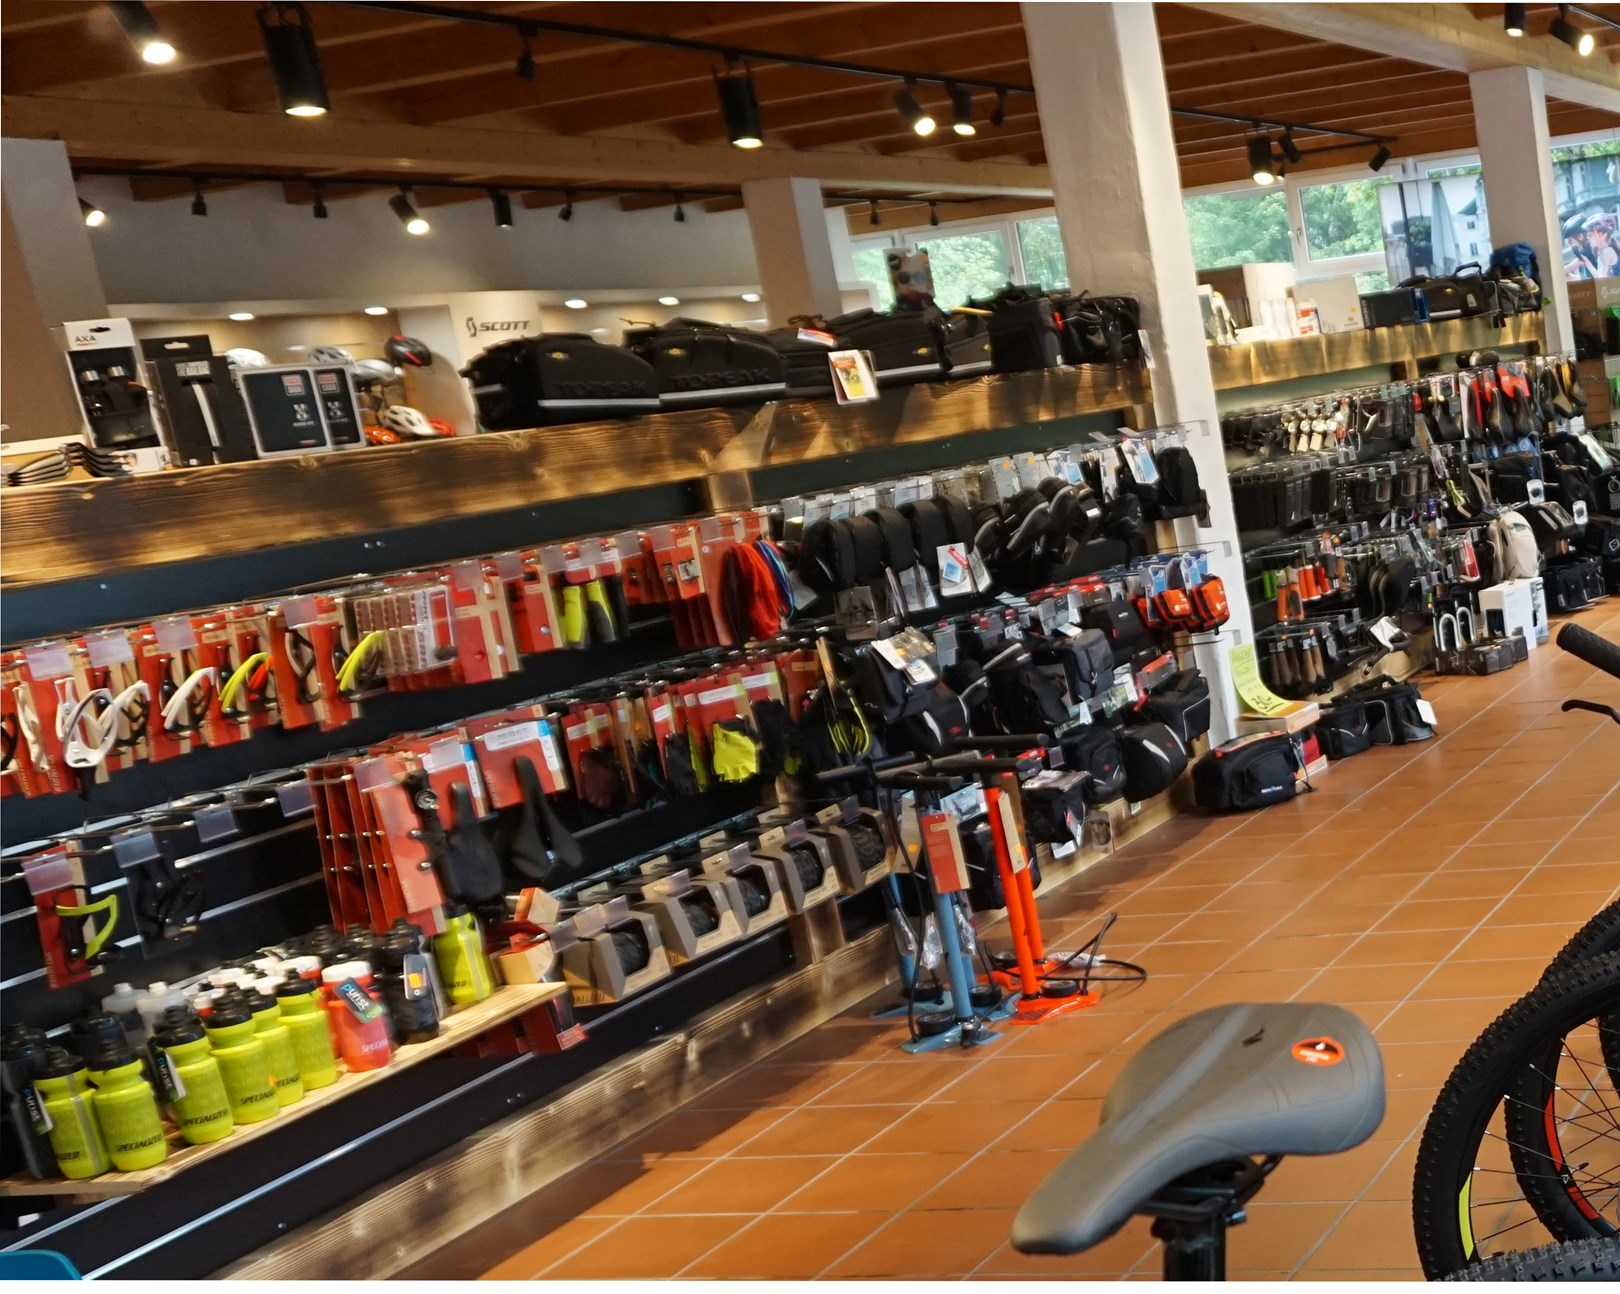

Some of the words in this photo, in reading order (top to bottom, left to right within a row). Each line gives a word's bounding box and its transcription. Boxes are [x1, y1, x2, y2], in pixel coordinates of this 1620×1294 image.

[478, 319, 531, 333] SCOTT
[74, 334, 98, 343] AXA
[340, 983, 371, 1013] purist
[182, 1107, 230, 1127] SPECIALIZED
[116, 1133, 163, 1152] SPECIALIZED
